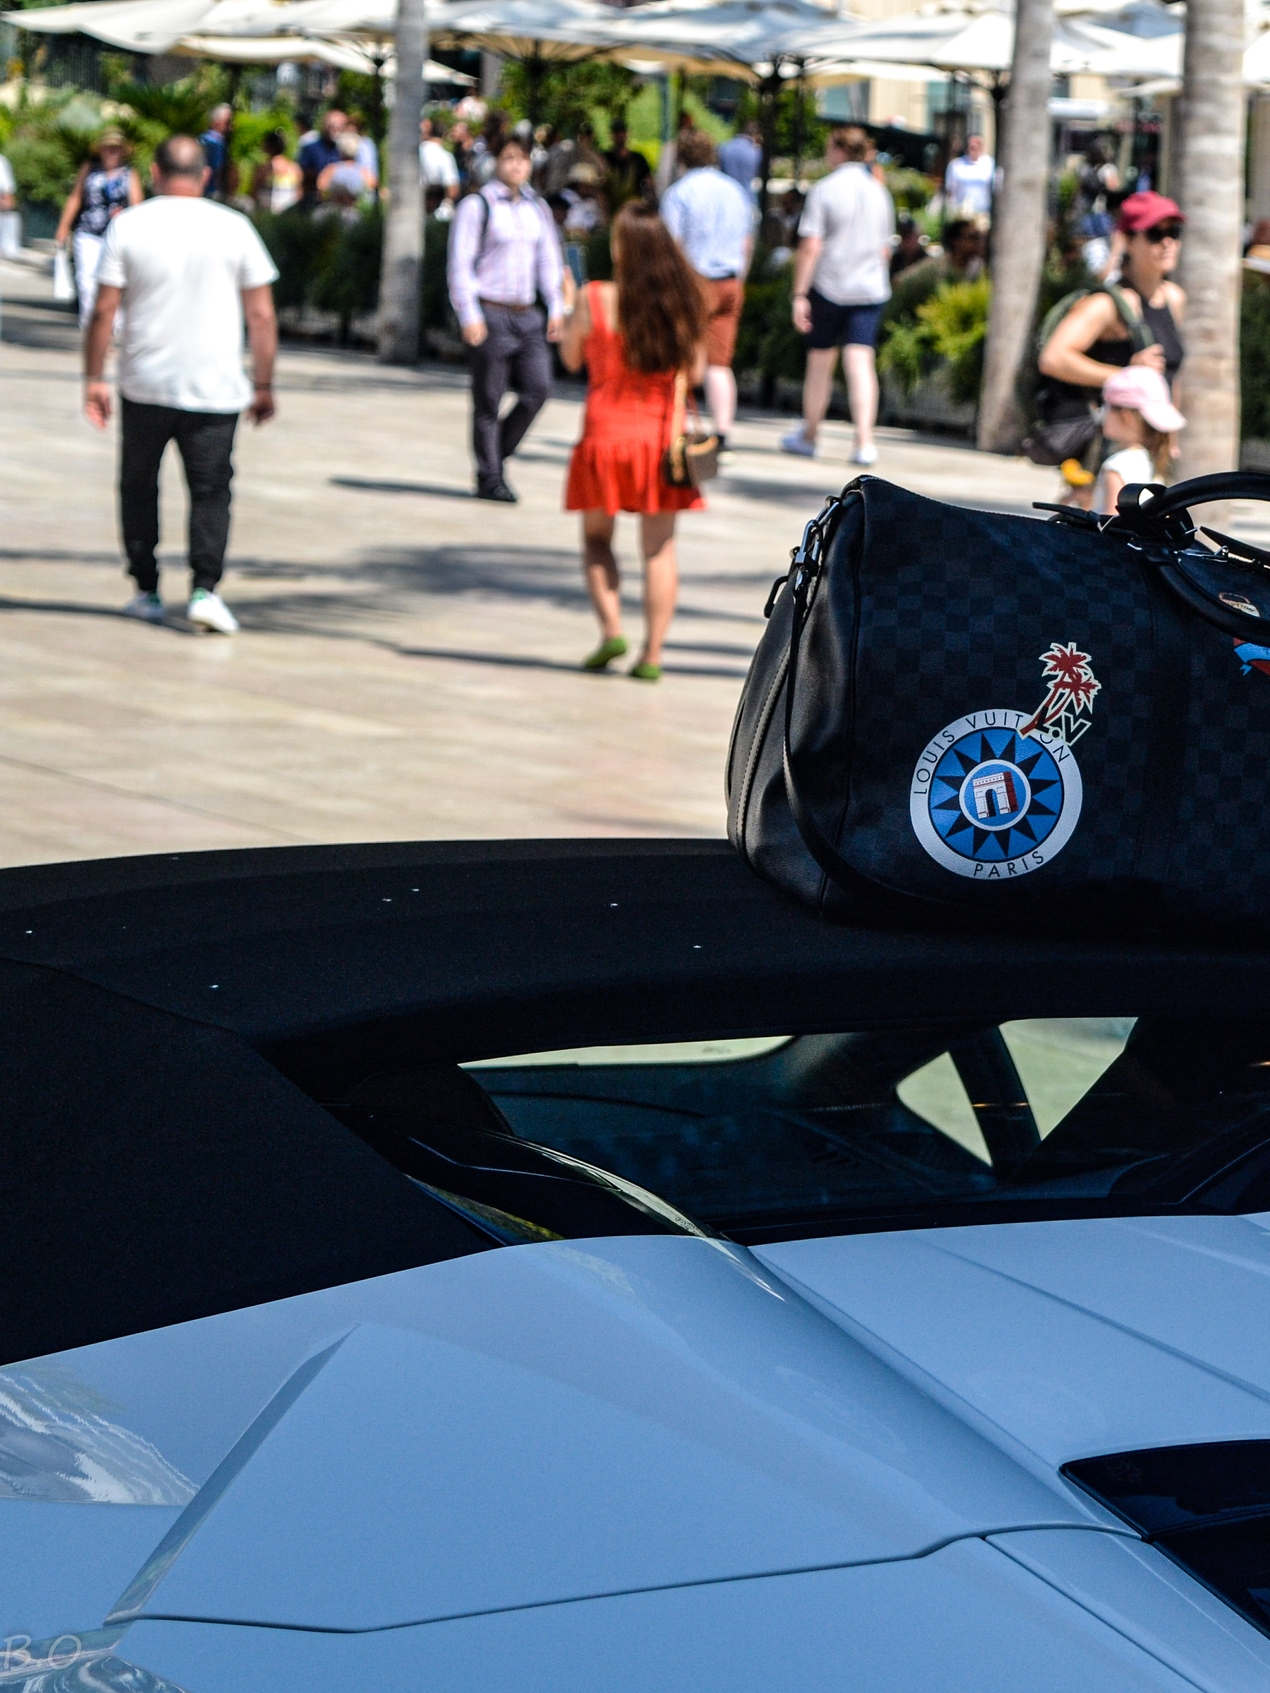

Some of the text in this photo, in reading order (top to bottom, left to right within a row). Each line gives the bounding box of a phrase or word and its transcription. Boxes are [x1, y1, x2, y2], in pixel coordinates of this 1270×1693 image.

[914, 711, 1070, 795] LOUIS VUITON
[973, 850, 1044, 878] PARIS
